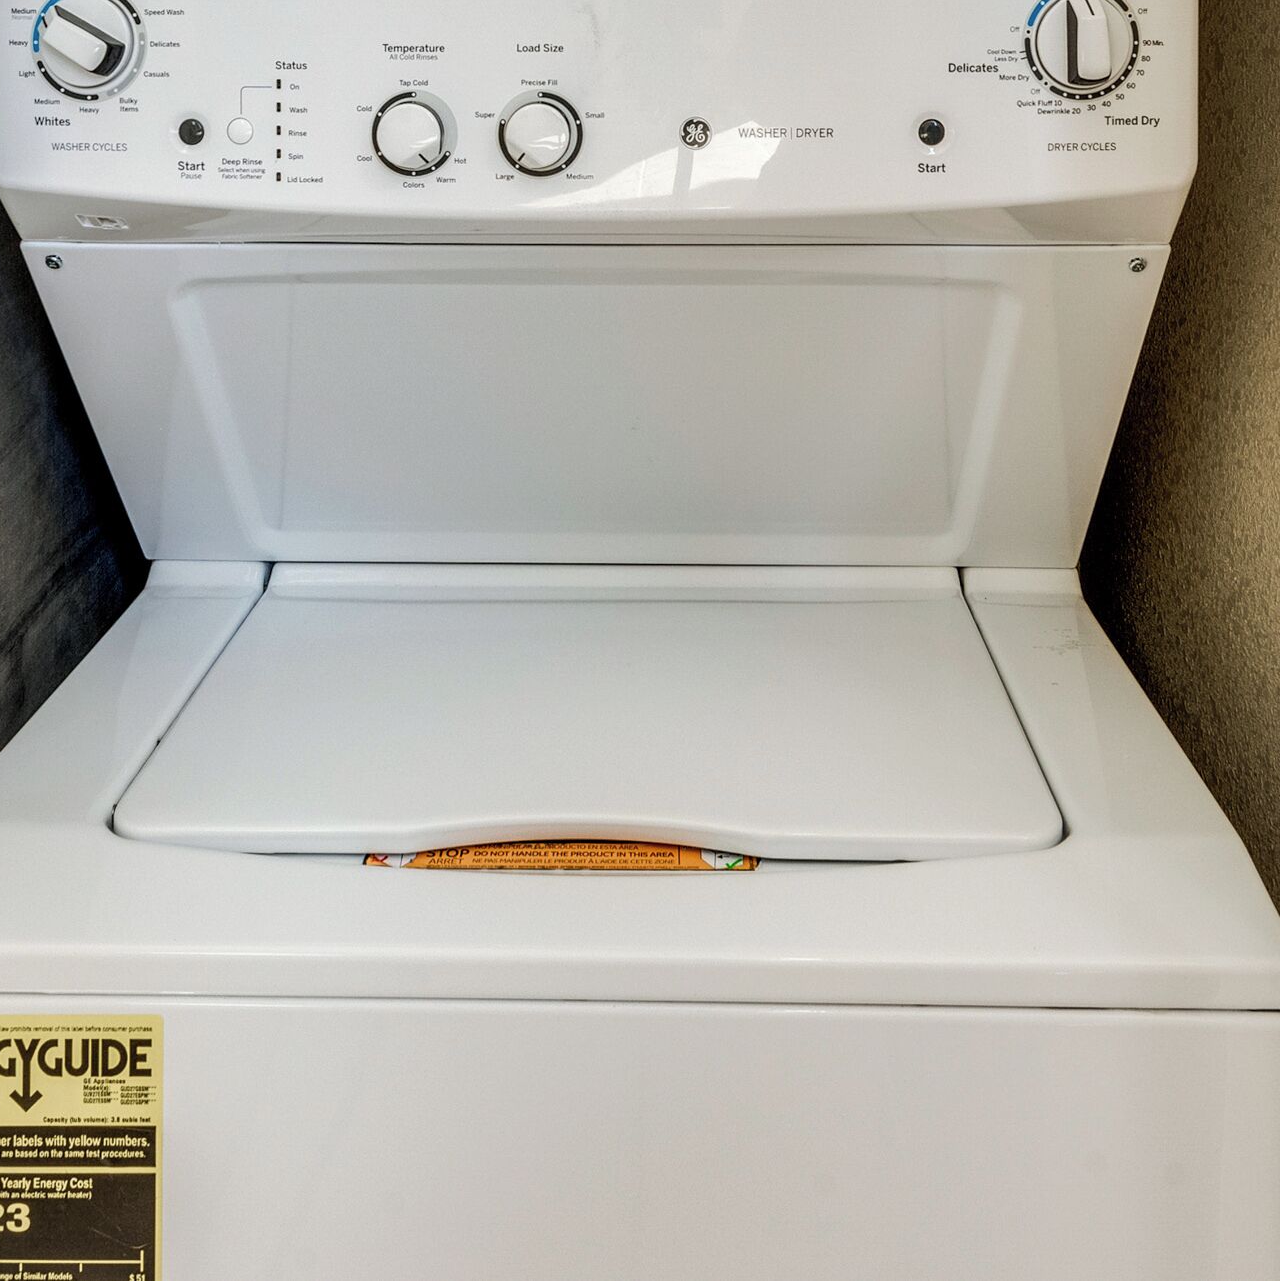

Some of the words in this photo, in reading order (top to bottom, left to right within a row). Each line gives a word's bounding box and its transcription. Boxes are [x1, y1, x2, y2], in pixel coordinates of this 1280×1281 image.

[144, 8, 163, 17] Speed
[164, 8, 185, 16] Wash
[9, 39, 29, 48] Heavy
[150, 40, 180, 48] Delicates
[383, 44, 445, 54] Temperature
[517, 44, 540, 53] Load
[543, 44, 564, 53] Size
[275, 60, 308, 70] Status
[948, 63, 999, 73] Delicates
[19, 70, 36, 79] Light
[400, 80, 412, 88] Tap
[413, 79, 428, 87] Cold
[34, 98, 61, 106] Medium
[120, 97, 138, 106] Bulky
[79, 106, 100, 115] Heavy
[120, 105, 139, 113] Items
[289, 106, 308, 114] Wash
[475, 112, 495, 120] Super
[35, 116, 71, 127] Whites
[1105, 116, 1139, 126] Timed
[1141, 116, 1160, 127] Dry
[288, 129, 307, 137] Rinse
[739, 128, 787, 138] WASHER
[796, 128, 834, 138] DRYER
[52, 143, 91, 152] WASHER
[92, 143, 128, 152] CYCLES
[1048, 143, 1078, 152] DRYER
[1081, 143, 1116, 151] CYCLES
[288, 153, 304, 161] Spin
[454, 157, 467, 165] Hot
[178, 161, 205, 171] Start
[222, 158, 241, 166] Deep
[918, 163, 946, 173] Start
[181, 172, 202, 180] Pause
[287, 176, 297, 184] Lid
[298, 176, 323, 184] Locked
[495, 173, 515, 182] Large
[426, 848, 470, 858] STOP
[13, 1134, 43, 1147] labels
[45, 1134, 66, 1147] with
[68, 1134, 101, 1149] yellow
[103, 1134, 150, 1147] numbers.
[1, 1150, 13, 1158] are
[15, 1149, 38, 1158] based
[39, 1150, 49, 1158] on
[51, 1149, 63, 1158] the
[64, 1150, 85, 1158] same
[86, 1149, 100, 1158] test
[101, 1149, 146, 1160] procedures.
[0, 1177, 31, 1191] Yearly
[33, 1178, 68, 1191] Energy
[70, 1178, 93, 1189] Cost
[21, 1191, 46, 1199] electric
[68, 1191, 92, 1200] heater)
[14, 1271, 21, 1280] of
[23, 1271, 47, 1280] Similar
[48, 1271, 73, 1280] Models
